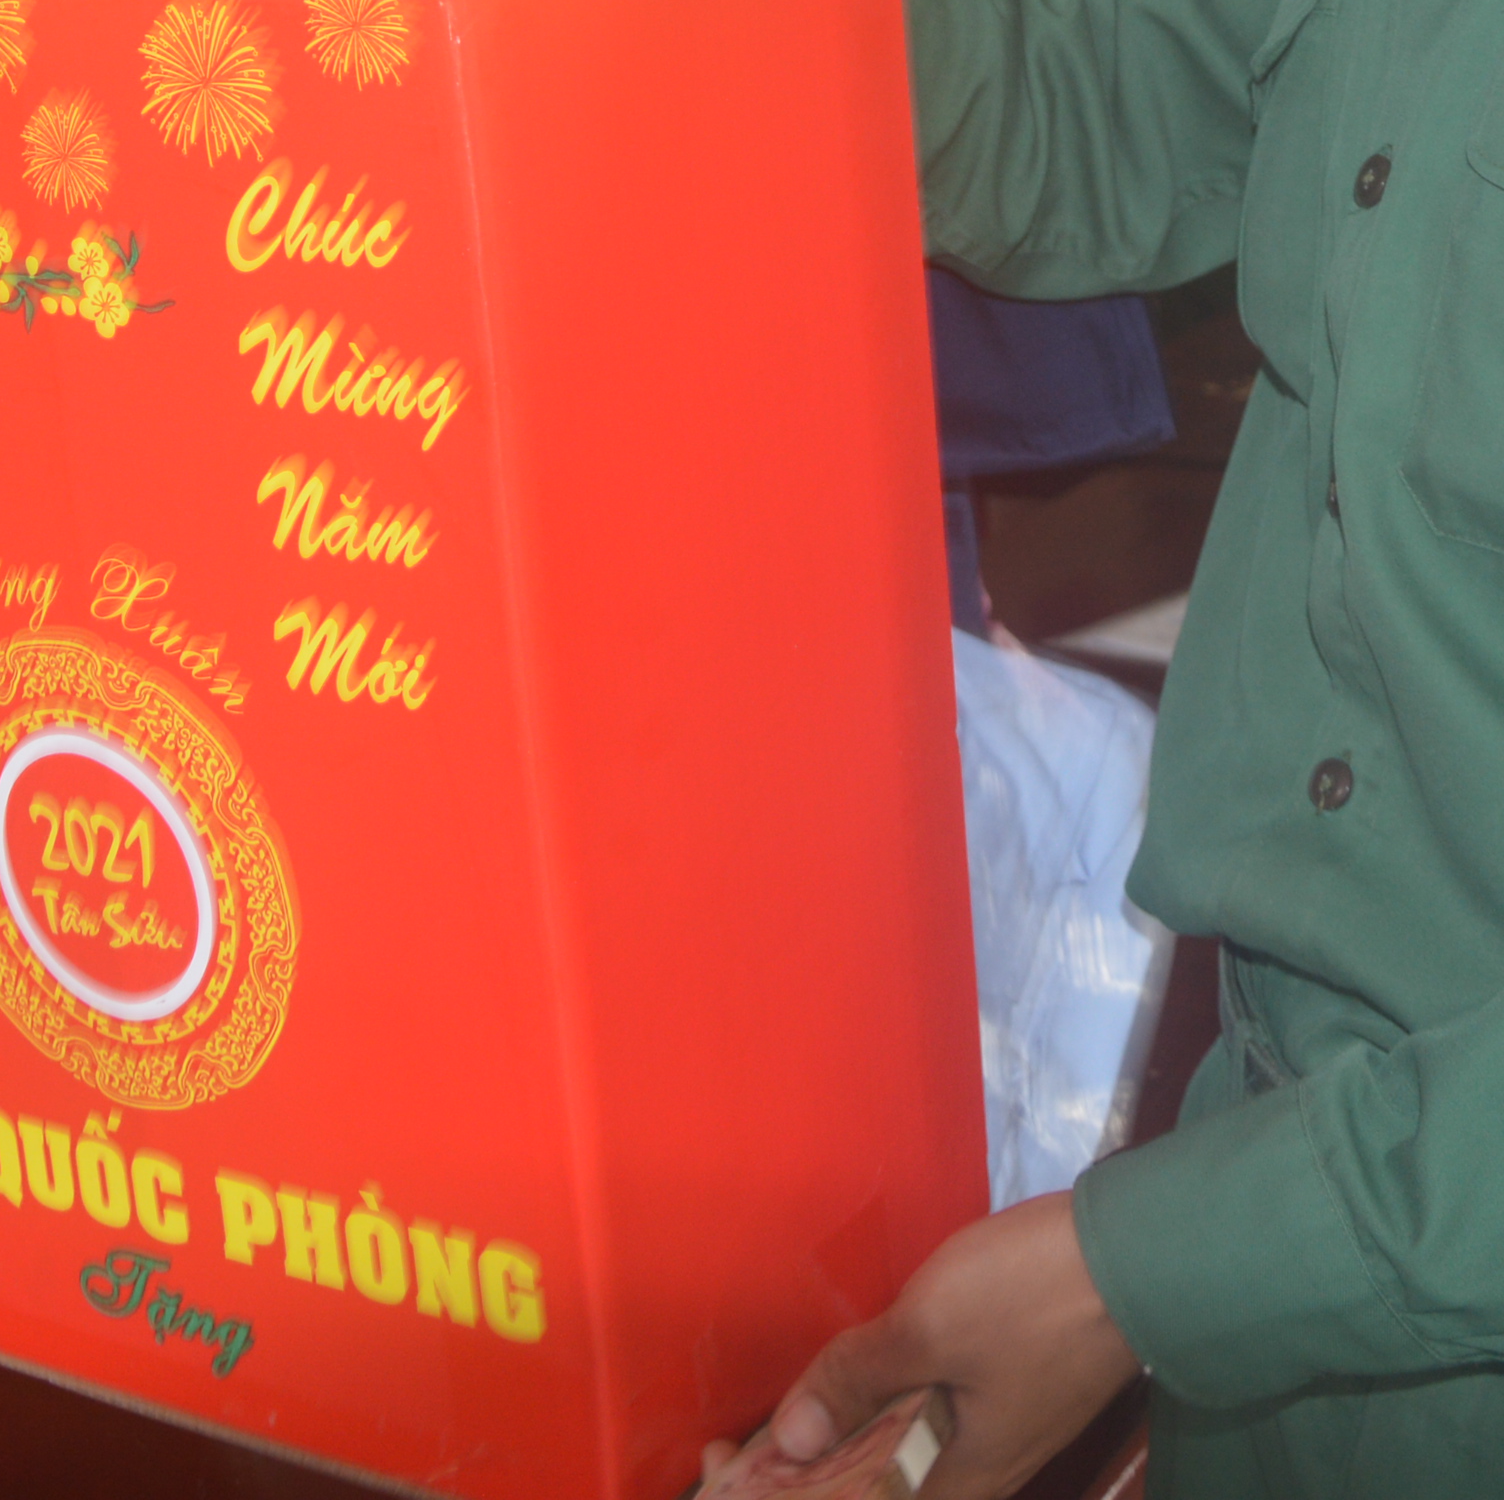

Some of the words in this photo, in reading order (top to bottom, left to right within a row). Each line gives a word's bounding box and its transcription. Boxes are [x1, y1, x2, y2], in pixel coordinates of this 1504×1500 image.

[225, 160, 409, 273] Chúc
[238, 308, 468, 452] Mừng
[256, 457, 435, 569] Năm
[90, 545, 251, 715] Xuân
[273, 599, 435, 711] Mới
[28, 793, 155, 889] 2021
[31, 880, 101, 937] Tân
[215, 1169, 546, 1344] PHÒNG
[79, 1249, 254, 1379] Tặng
